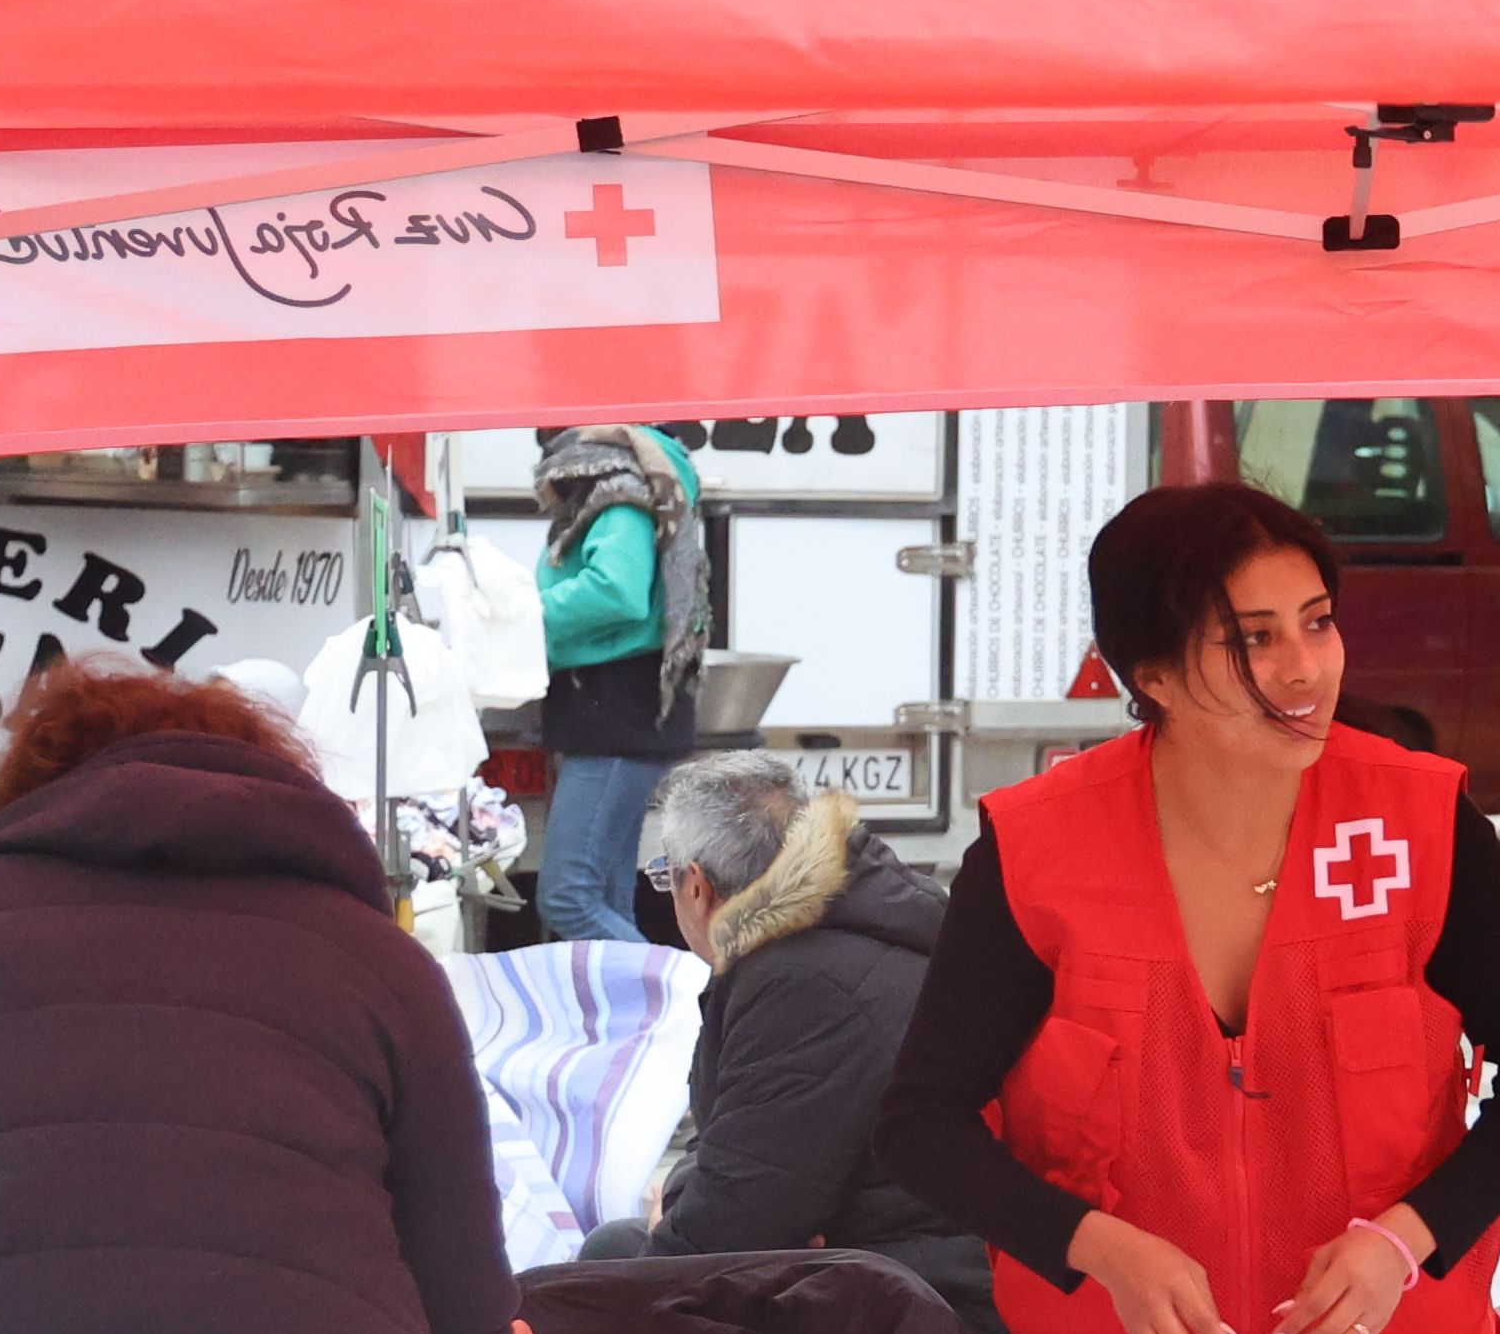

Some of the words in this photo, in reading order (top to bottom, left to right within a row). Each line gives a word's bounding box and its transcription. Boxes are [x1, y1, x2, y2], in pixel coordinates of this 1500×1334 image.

[226, 547, 287, 604] Desde
[288, 549, 344, 607] 1970
[842, 754, 902, 791] KGZ
